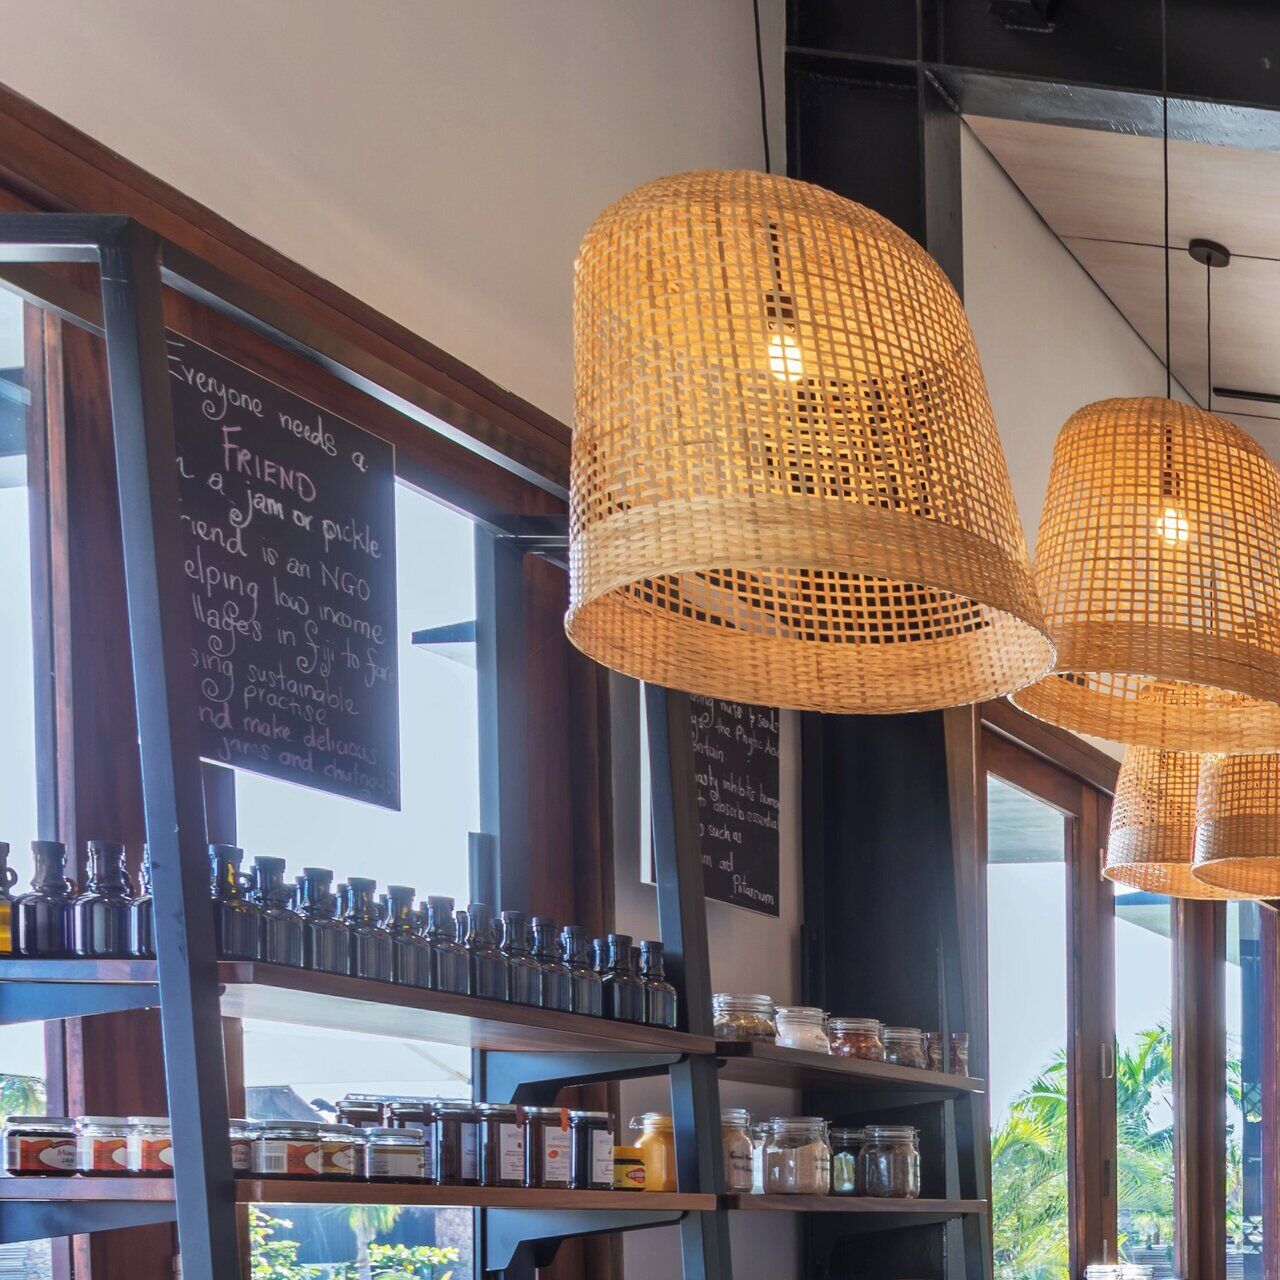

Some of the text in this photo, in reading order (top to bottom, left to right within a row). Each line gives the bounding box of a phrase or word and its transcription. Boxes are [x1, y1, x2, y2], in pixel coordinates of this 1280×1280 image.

[279, 412, 337, 456] needs
[221, 425, 316, 503] FRIEND
[208, 472, 382, 558] a jam or pickle
[262, 537, 279, 566] is
[286, 556, 311, 580] an
[321, 559, 371, 601] NGO
[184, 549, 385, 645] elping low income
[277, 617, 296, 647] in
[341, 638, 360, 669] to
[244, 686, 327, 725] practise
[248, 659, 360, 715] sustainable
[198, 703, 233, 730] nd
[243, 714, 294, 743] make
[278, 750, 314, 773] and
